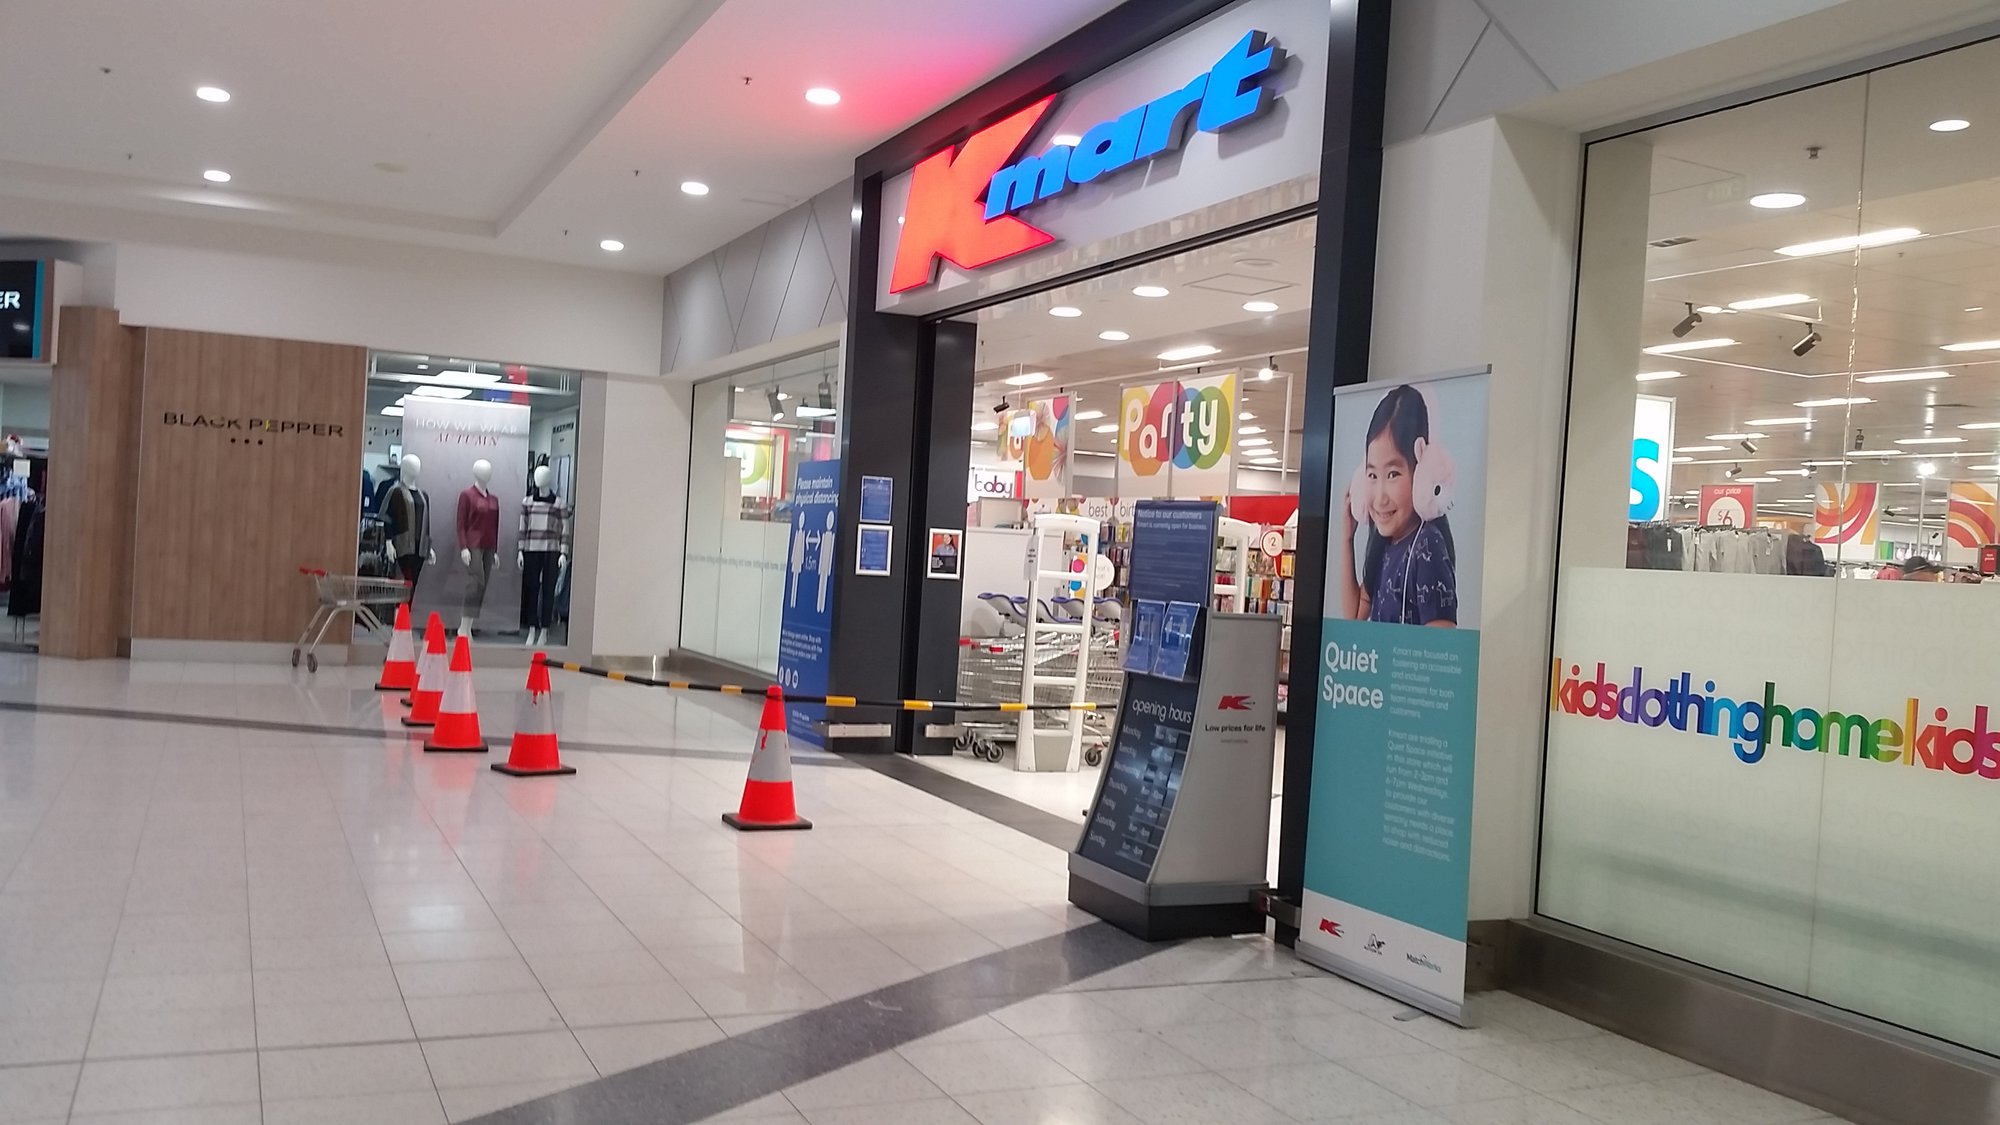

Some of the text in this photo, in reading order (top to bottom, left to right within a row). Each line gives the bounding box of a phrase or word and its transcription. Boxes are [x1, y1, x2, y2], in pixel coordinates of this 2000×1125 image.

[890, 29, 1277, 294] Kmart
[164, 412, 343, 437] BLACK PEPPER
[416, 417, 449, 430] HOW
[1124, 398, 1218, 458] Party
[436, 433, 499, 446] AUTUMN
[798, 476, 832, 489] Please maintain
[795, 491, 839, 507] physical distancing
[1726, 488, 1741, 496] price
[1089, 502, 1108, 517] best
[1138, 509, 1202, 519] Notice to our customers
[1325, 641, 1378, 674] Quiet
[1392, 647, 1459, 661] Kmart are focused on
[1392, 658, 1462, 675] fostering an accessible
[1391, 670, 1430, 683] and inclusive
[1322, 675, 1384, 709] Space
[1390, 683, 1454, 698] environment for both
[1390, 695, 1448, 711] team members and
[1132, 699, 1192, 724] opening hours
[1122, 724, 1142, 741] Monday
[1205, 723, 1266, 734] Low prices for life
[1118, 742, 1137, 758] Tuesday
[1388, 740, 1405, 751] Quiet
[1406, 743, 1425, 756] Space
[1443, 740, 1448, 748] a
[1422, 761, 1441, 771] which
[1108, 777, 1128, 795] Thursday
[1102, 796, 1116, 810] Friday
[1392, 791, 1417, 803] provide
[1095, 814, 1117, 832] Saturday
[1088, 832, 1107, 849] Sunday
